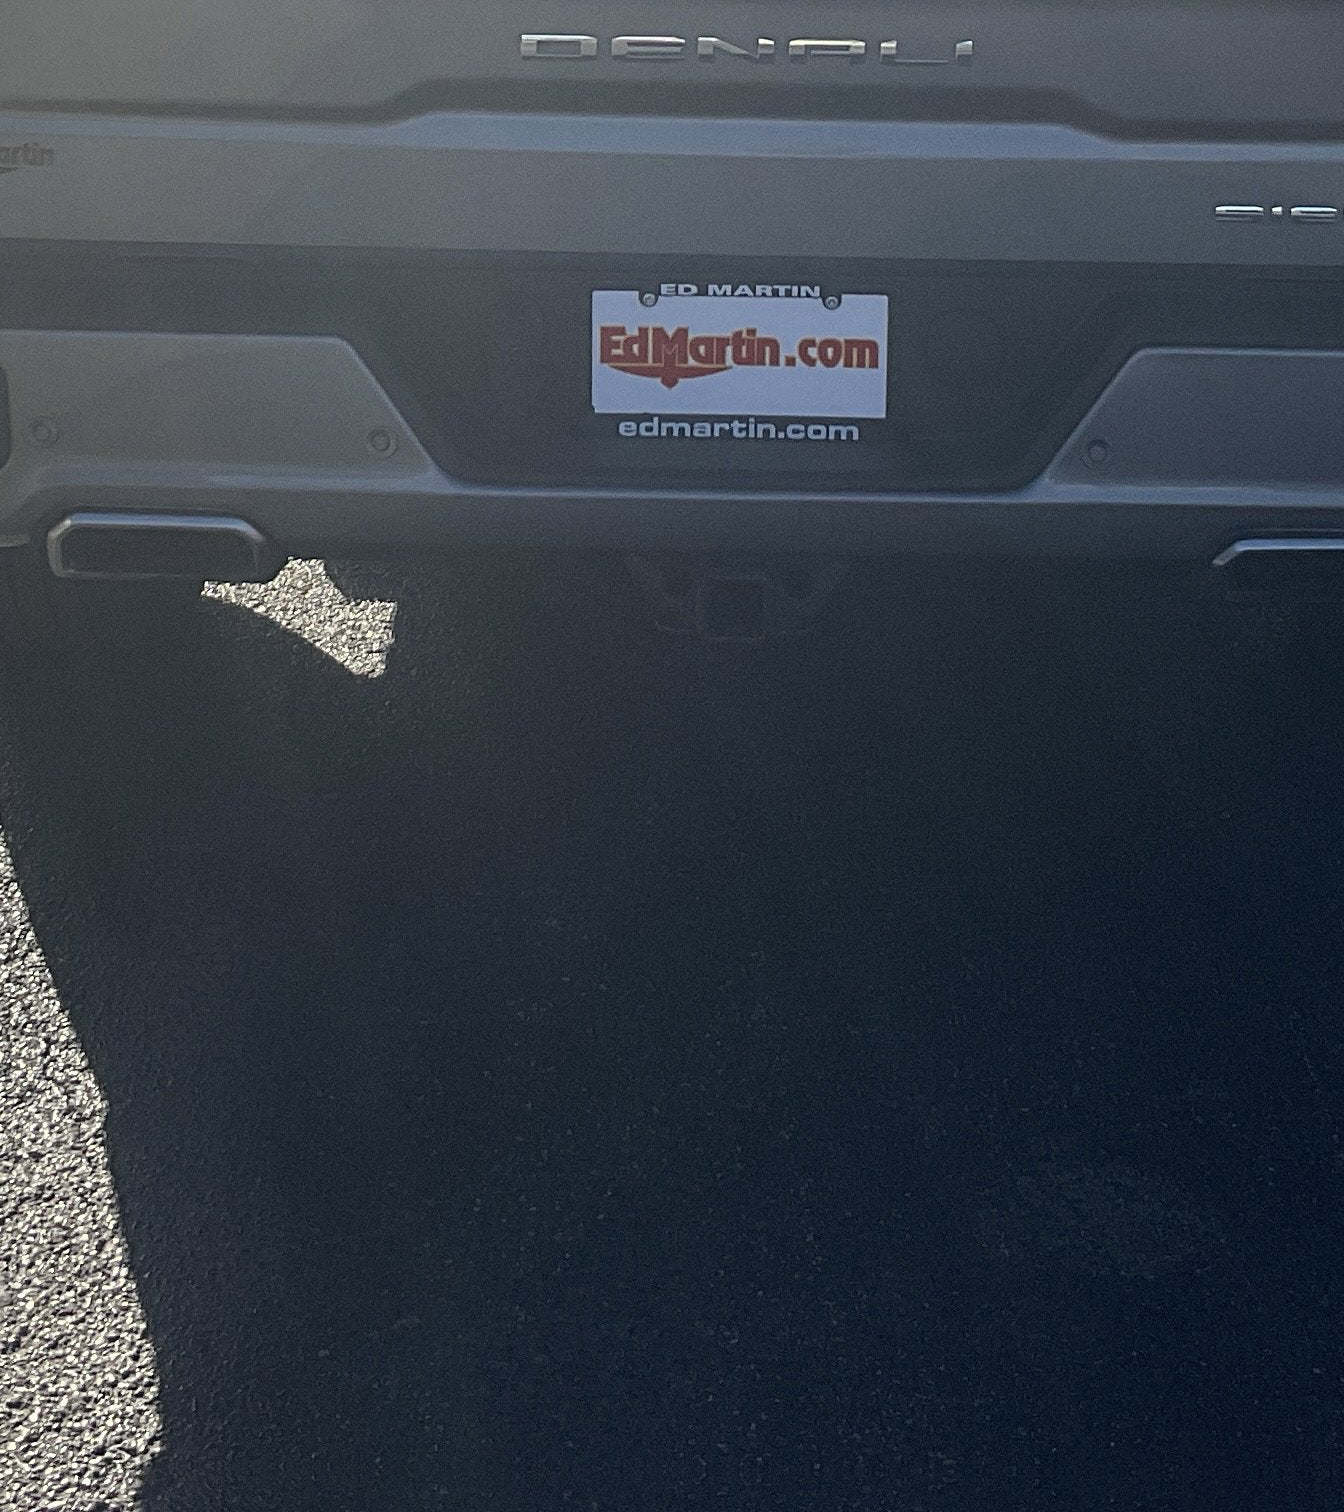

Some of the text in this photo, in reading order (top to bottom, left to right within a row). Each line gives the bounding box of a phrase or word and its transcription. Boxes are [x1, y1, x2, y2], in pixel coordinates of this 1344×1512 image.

[520, 33, 974, 64] DENALI
[660, 283, 820, 298] ED MARTIN
[599, 325, 880, 371] EdMartin.com
[618, 416, 860, 441] edmartin.com
